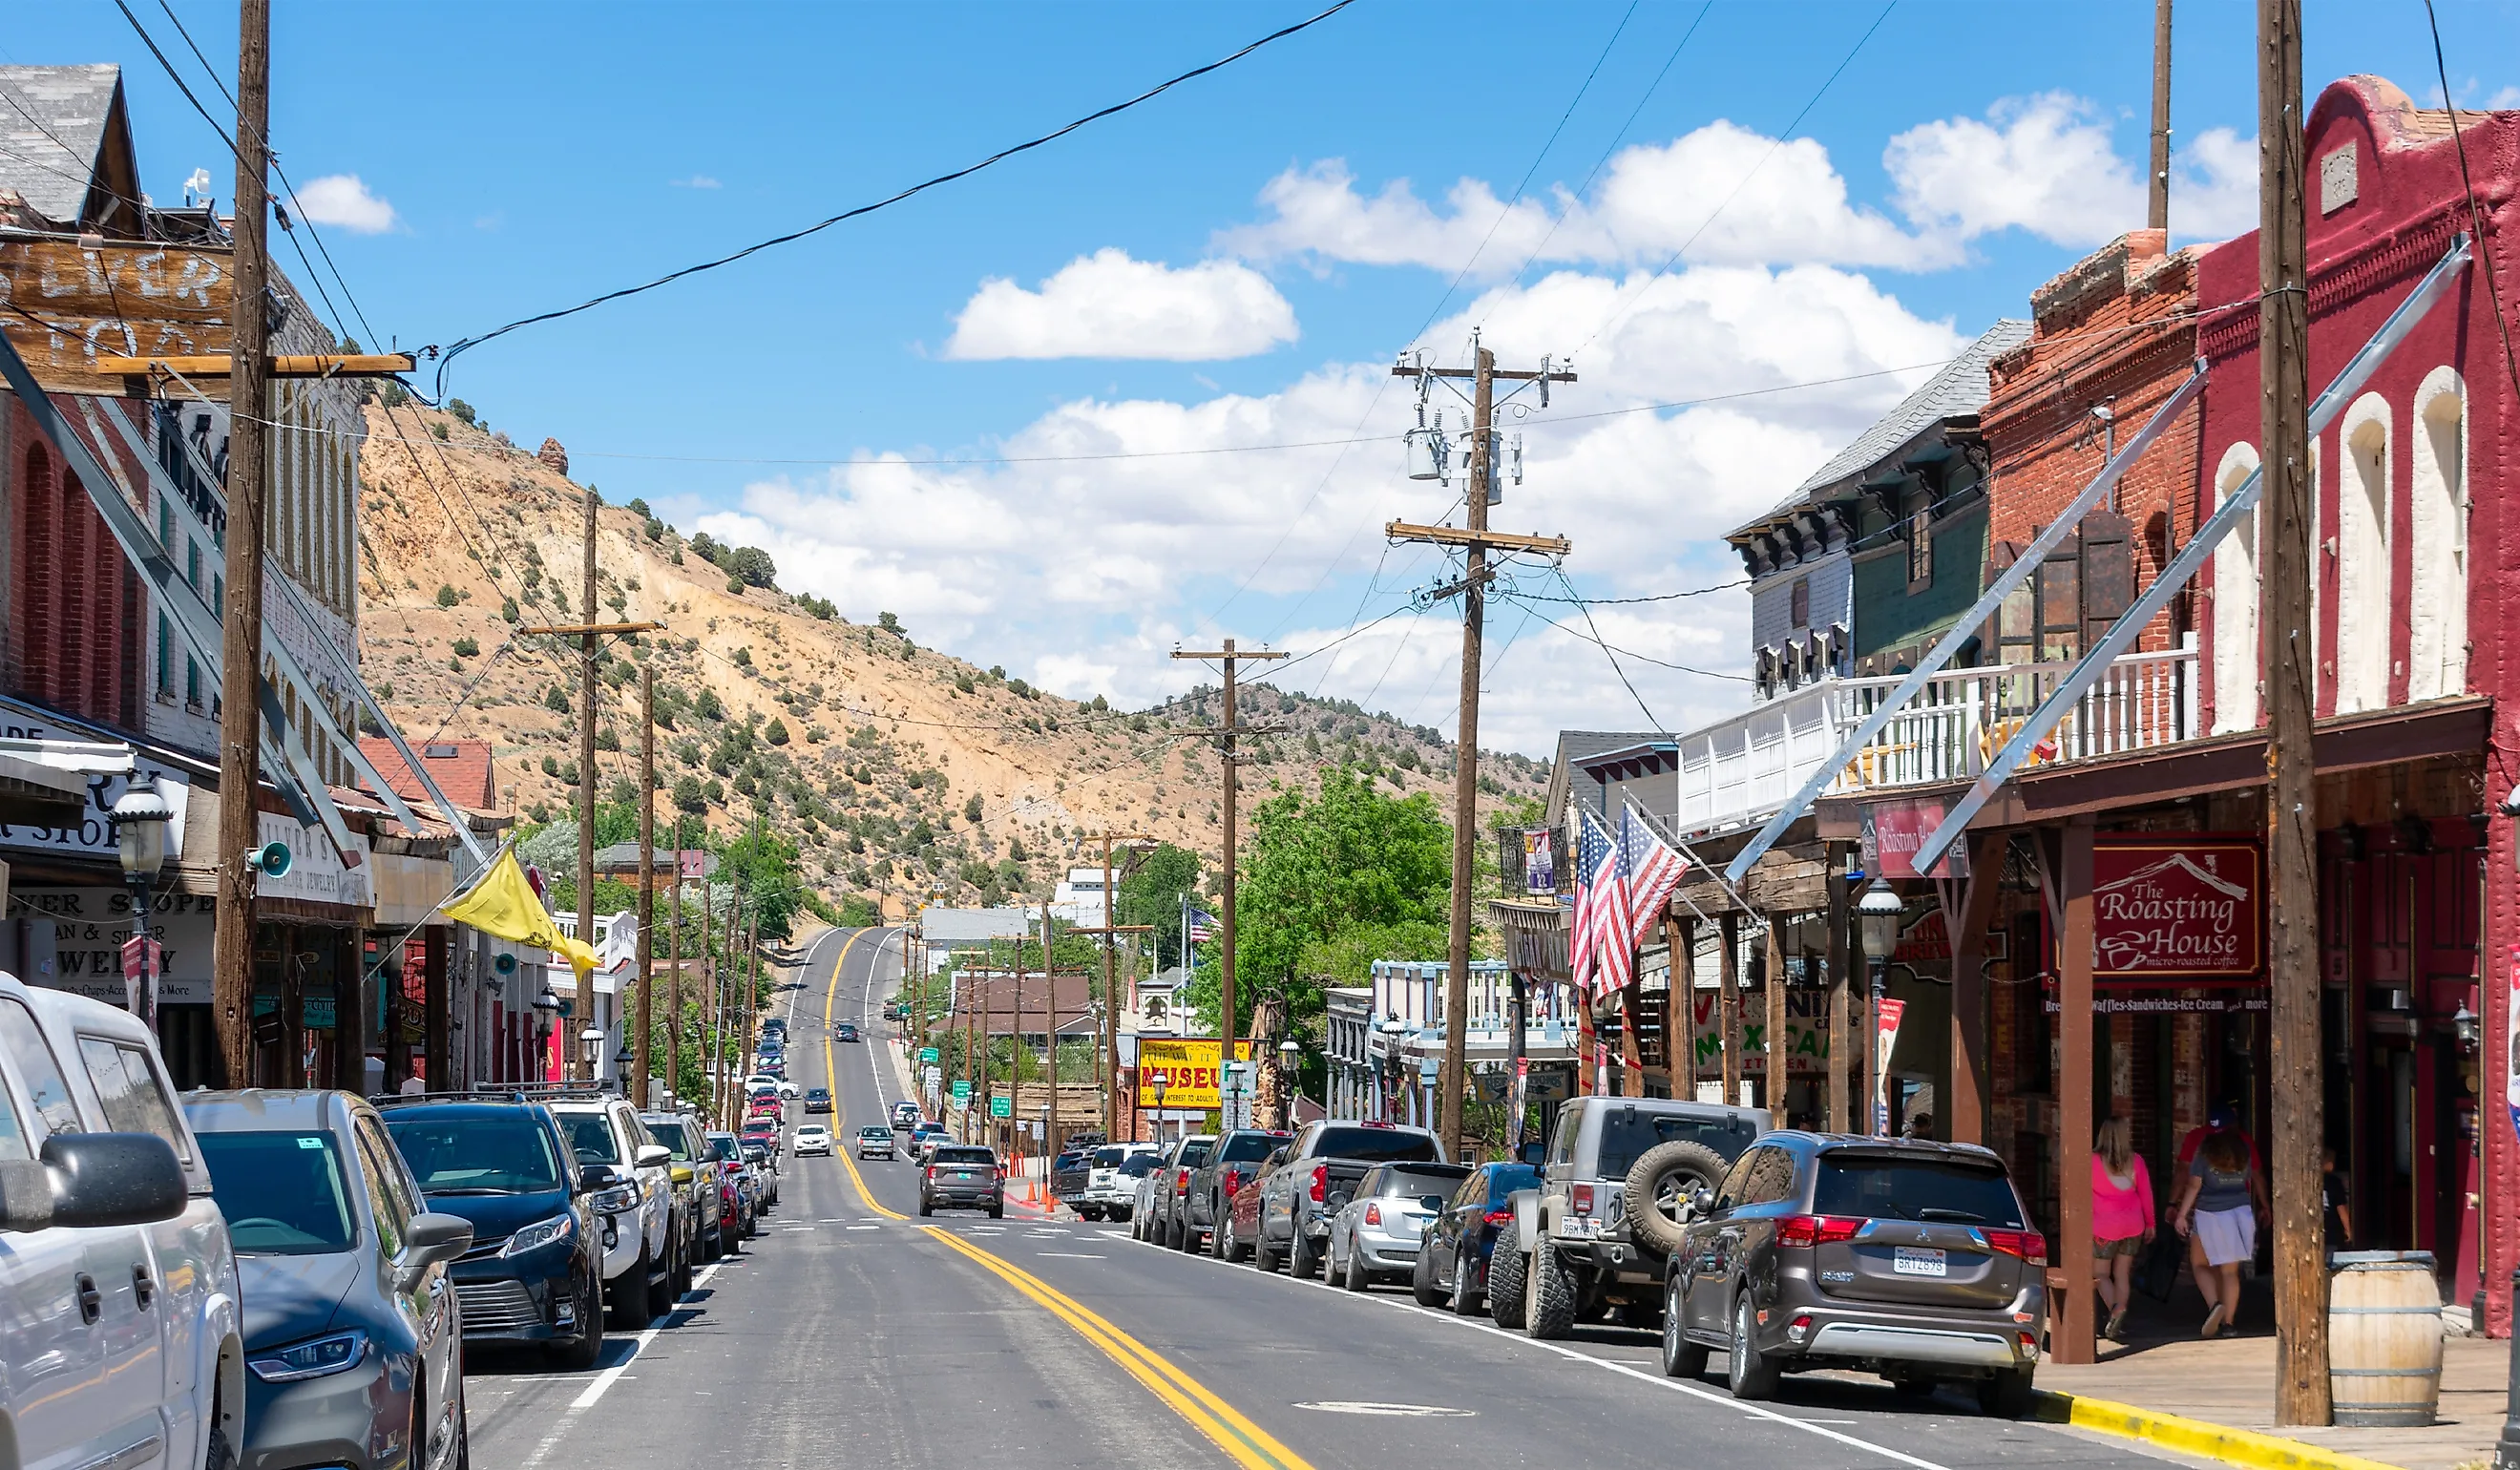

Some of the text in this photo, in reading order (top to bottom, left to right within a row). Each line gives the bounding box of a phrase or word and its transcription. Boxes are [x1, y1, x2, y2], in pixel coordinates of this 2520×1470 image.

[2132, 880, 2164, 899] The
[2100, 892, 2235, 934] Roasting
[84, 923, 99, 940] &
[2147, 920, 2238, 955] House
[2146, 954, 2238, 970] micro-roasted coffee
[167, 984, 189, 996] More
[2196, 998, 2223, 1010] Cream
[2245, 999, 2268, 1010] more
[1145, 1052, 1166, 1060] THE
[1172, 1052, 1191, 1060] WAY
[1142, 1067, 1220, 1088] MUSEU
